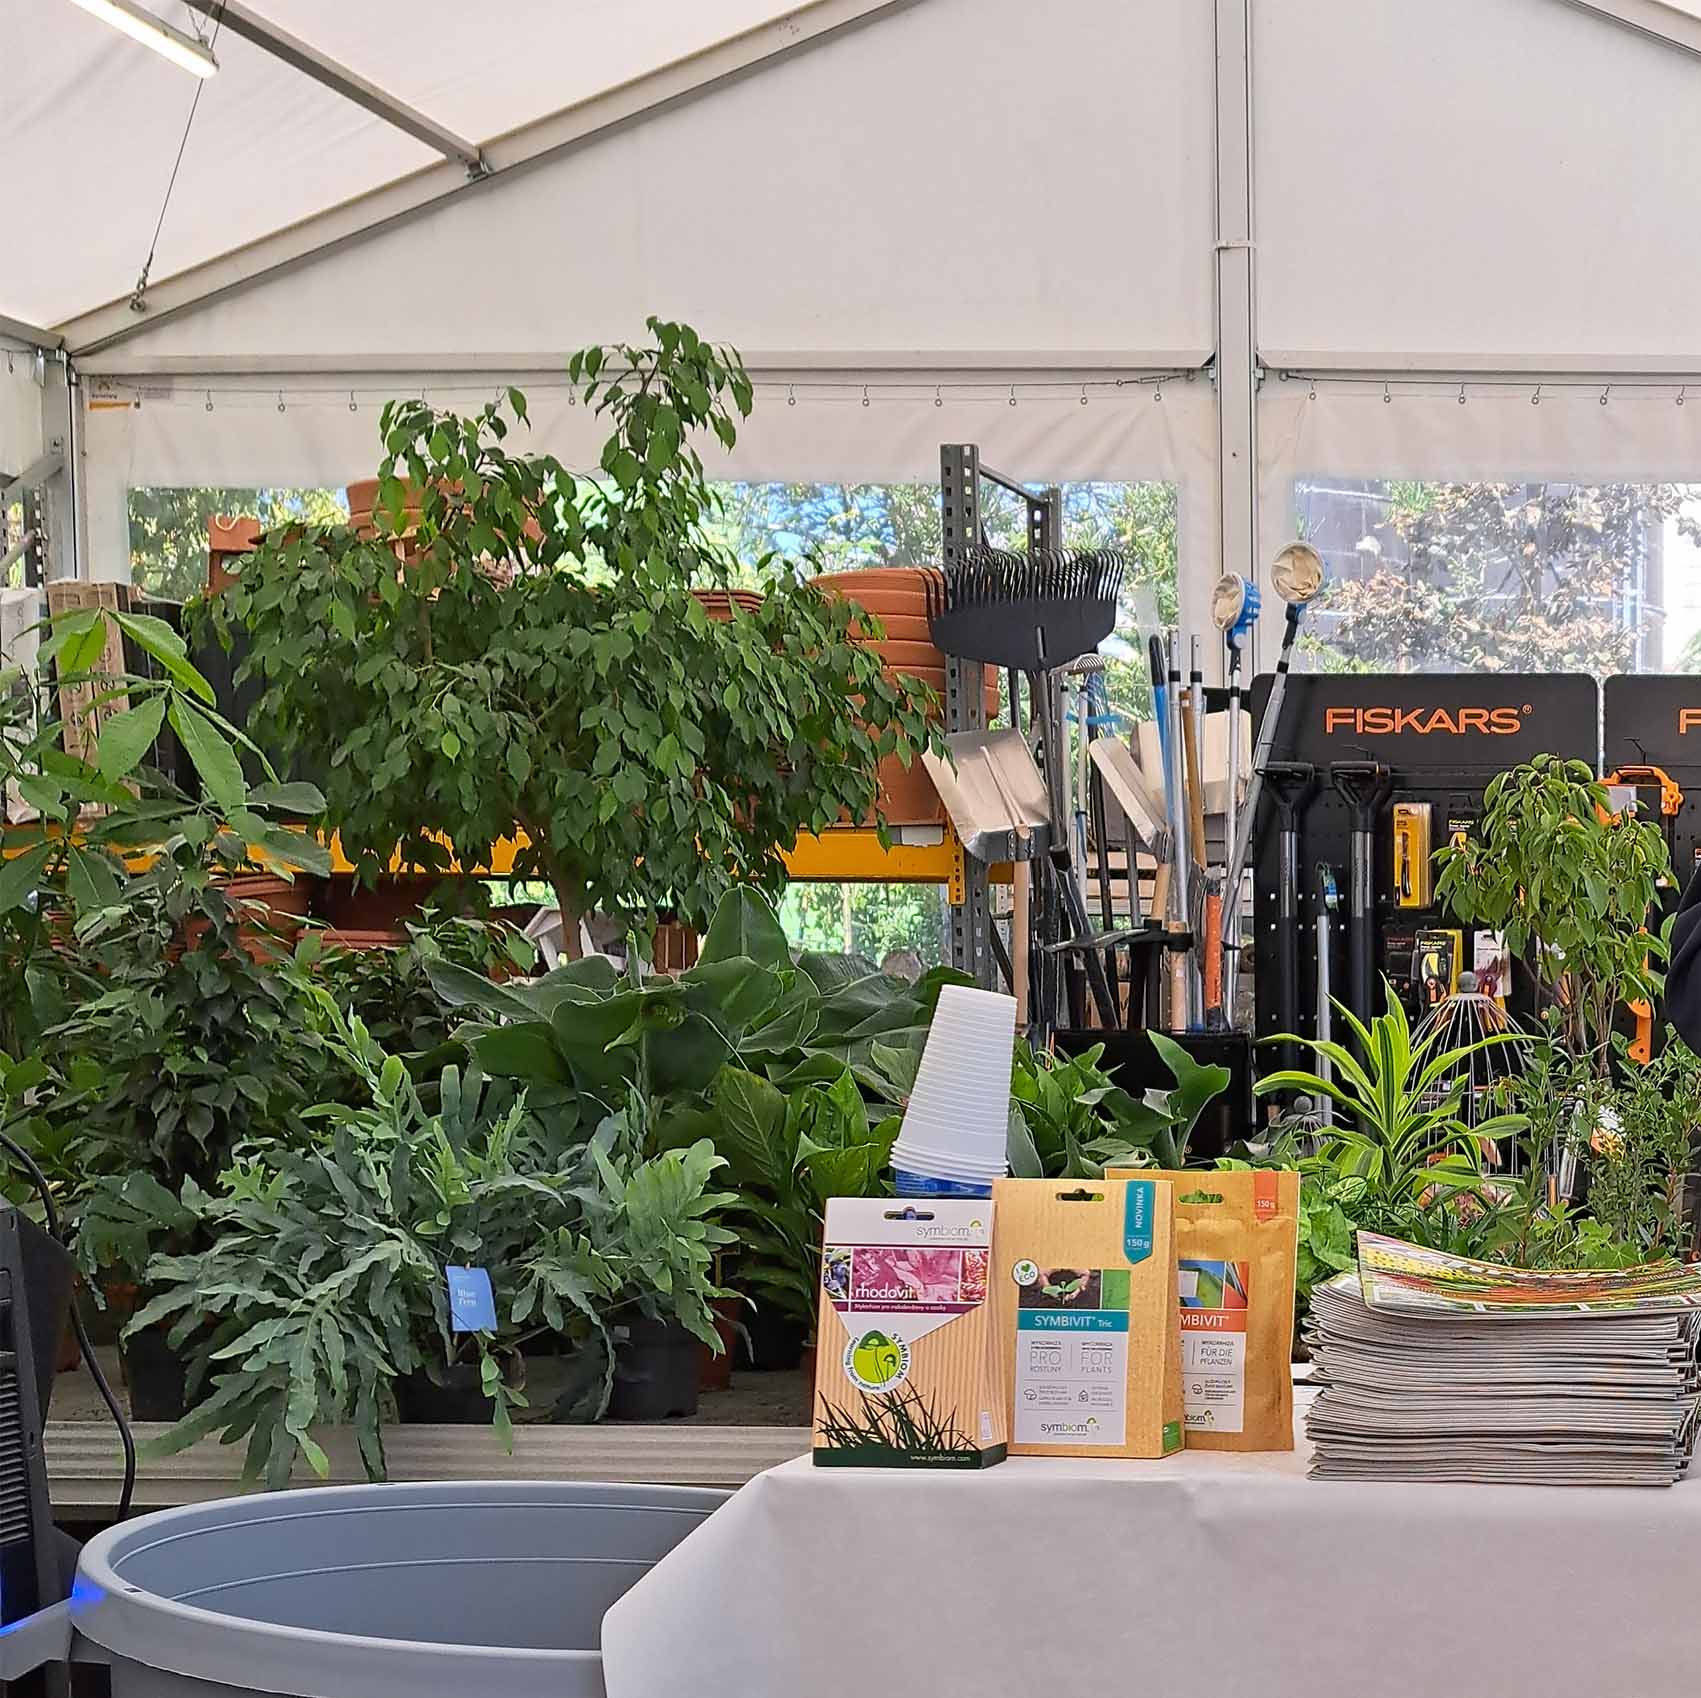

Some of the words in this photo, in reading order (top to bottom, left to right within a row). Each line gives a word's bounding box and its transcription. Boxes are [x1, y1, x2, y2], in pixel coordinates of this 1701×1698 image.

[1135, 1187, 1144, 1228] NOVINKA
[1019, 1271, 1035, 1282] ECO
[855, 1285, 914, 1299] rhodovit
[891, 1333, 909, 1379] SYMBIOM
